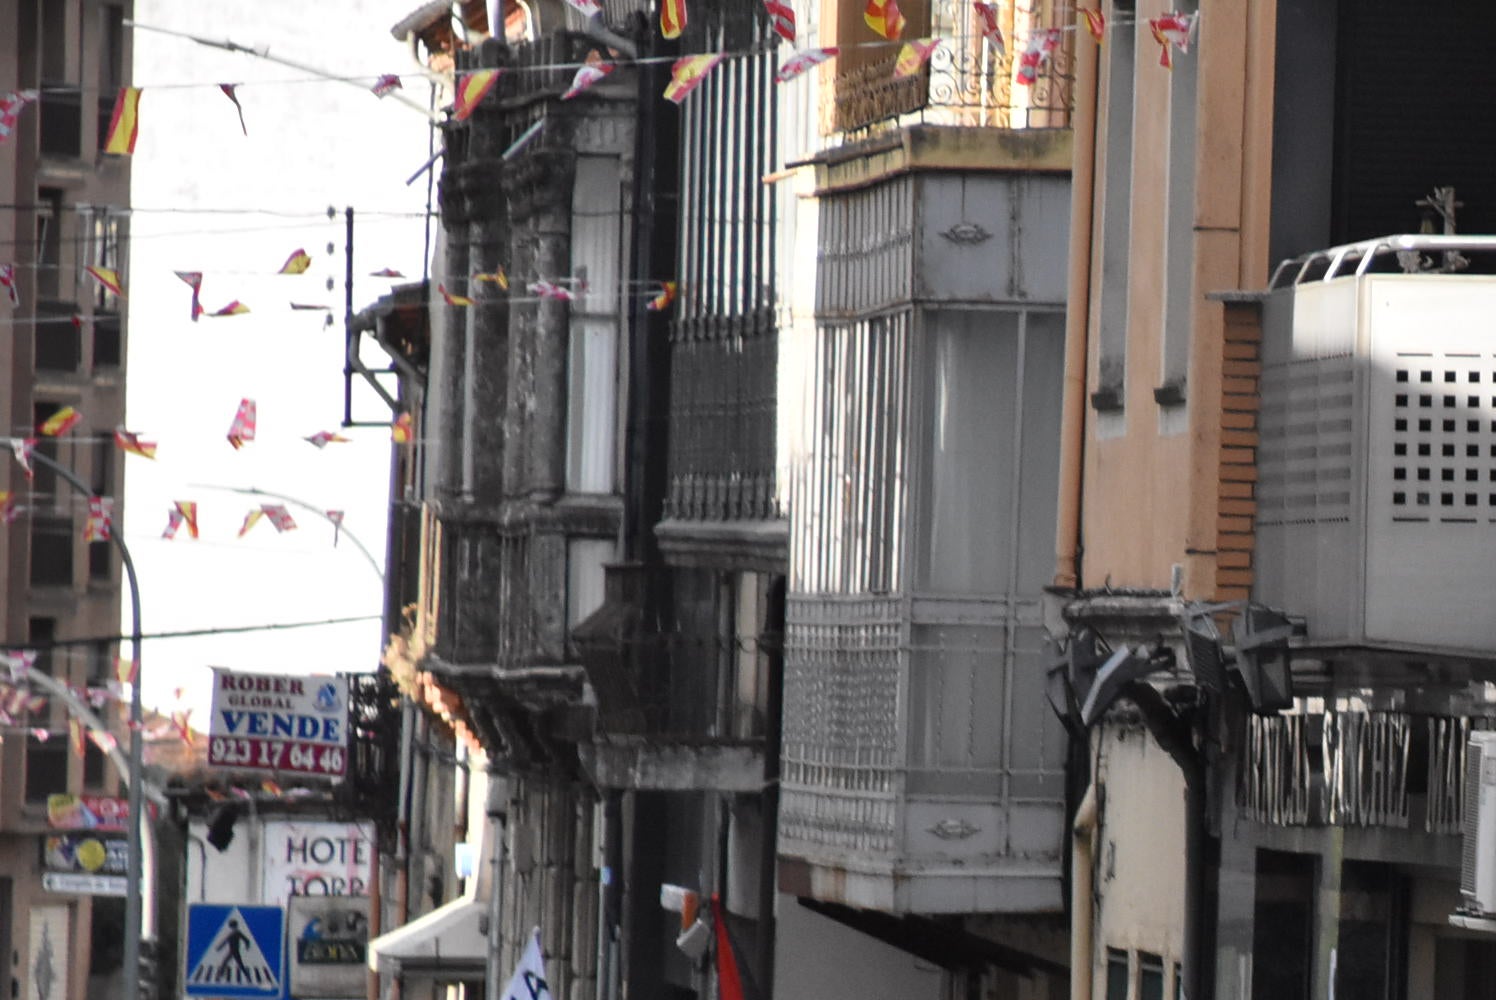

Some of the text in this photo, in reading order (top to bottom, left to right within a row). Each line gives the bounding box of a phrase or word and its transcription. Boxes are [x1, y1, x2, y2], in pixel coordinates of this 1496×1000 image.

[221, 674, 304, 697] ROBER
[227, 694, 294, 710] GLOBAL
[221, 709, 340, 742] VENDE
[212, 737, 251, 764] 923
[258, 741, 283, 768] 17
[1243, 712, 1311, 828] ARNICAS
[286, 836, 367, 865] HOTE
[286, 873, 364, 897] TORR
